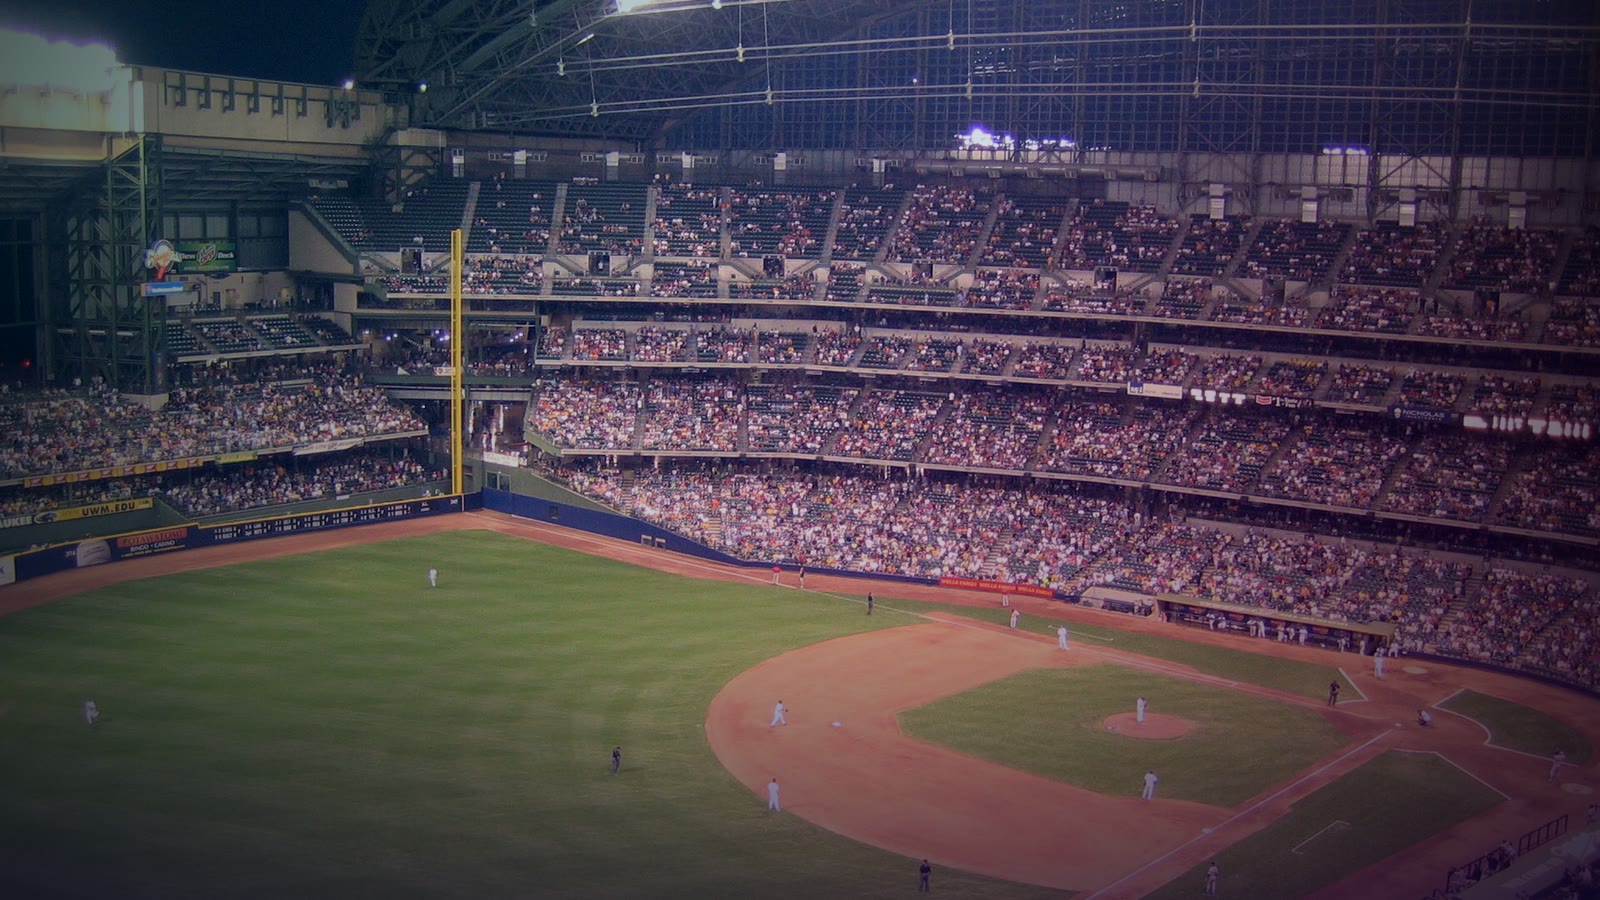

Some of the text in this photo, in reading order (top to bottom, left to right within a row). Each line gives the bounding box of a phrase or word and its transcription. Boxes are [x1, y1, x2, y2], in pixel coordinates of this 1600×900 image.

[217, 251, 234, 259] Deck
[1402, 409, 1445, 418] NICHOLAS
[81, 502, 136, 516] UWM.EDU
[154, 540, 176, 549] CASINO
